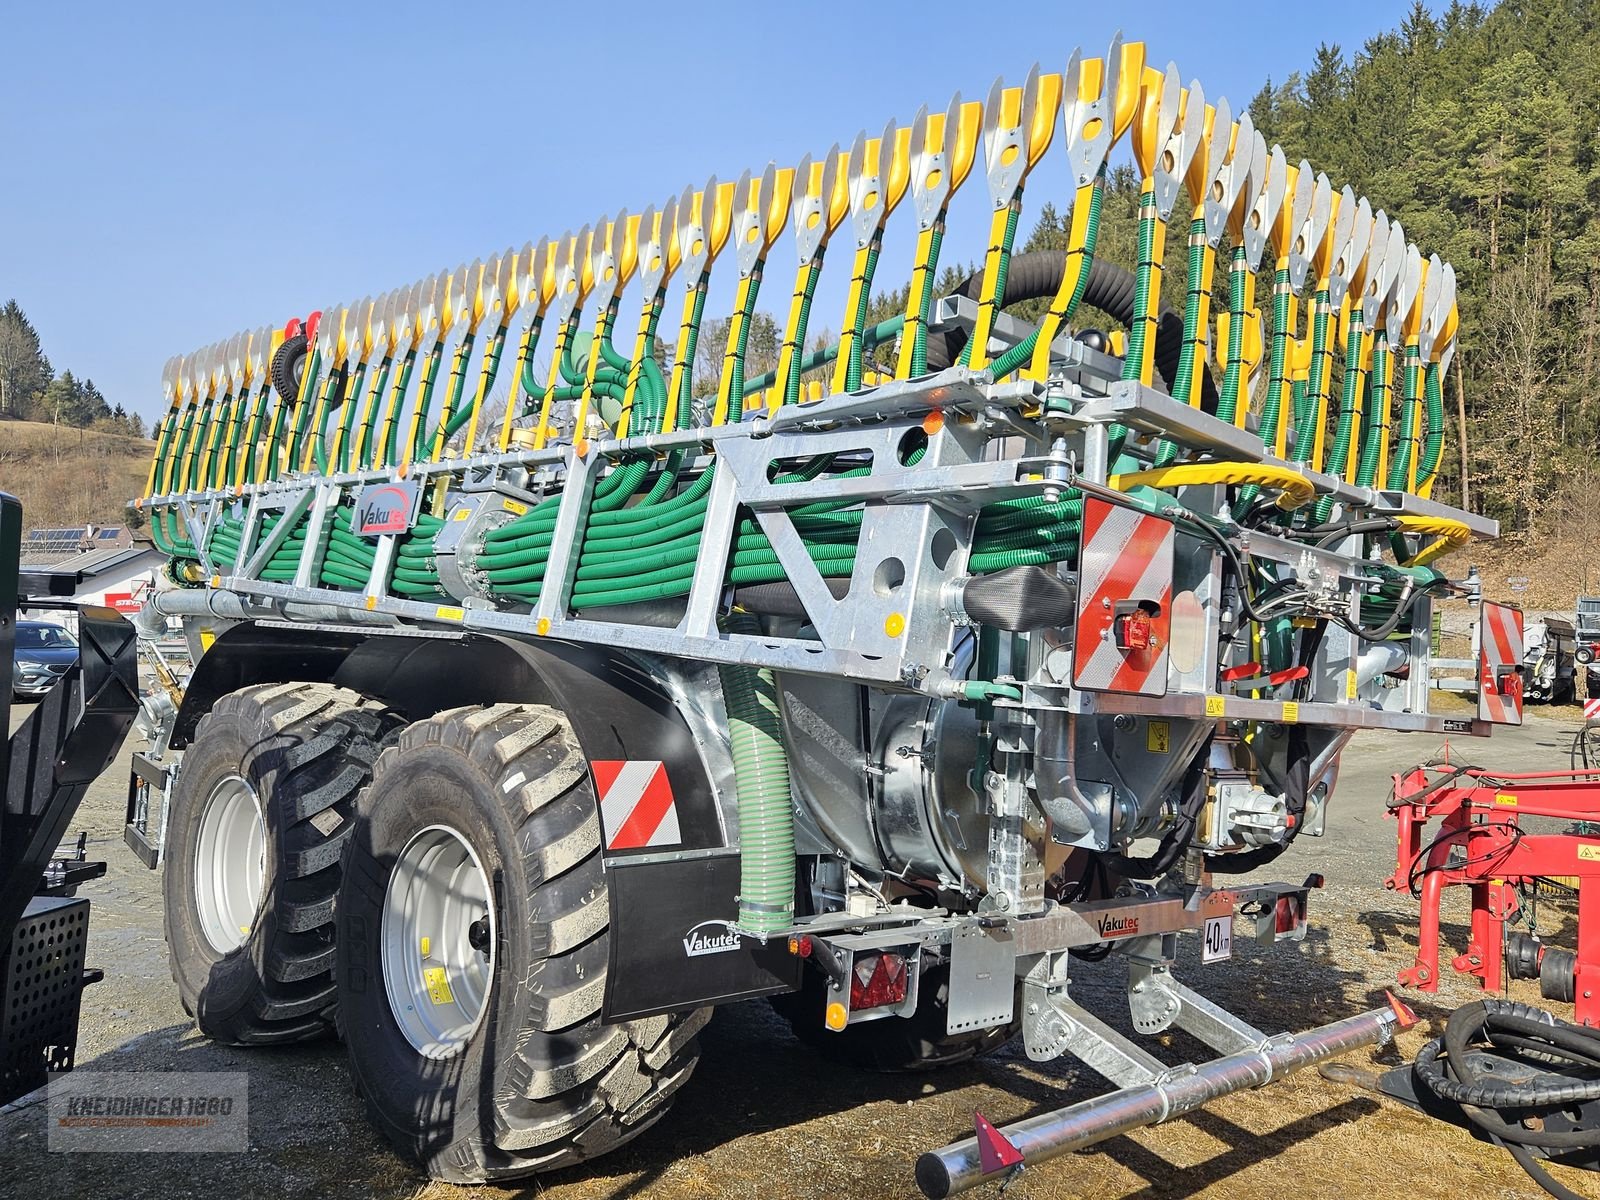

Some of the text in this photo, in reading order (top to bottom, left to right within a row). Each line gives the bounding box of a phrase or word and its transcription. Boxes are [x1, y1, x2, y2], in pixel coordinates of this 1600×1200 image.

[360, 502, 407, 532] Vakutec
[1098, 914, 1139, 937] Vakutec
[683, 932, 741, 957] Vakutec
